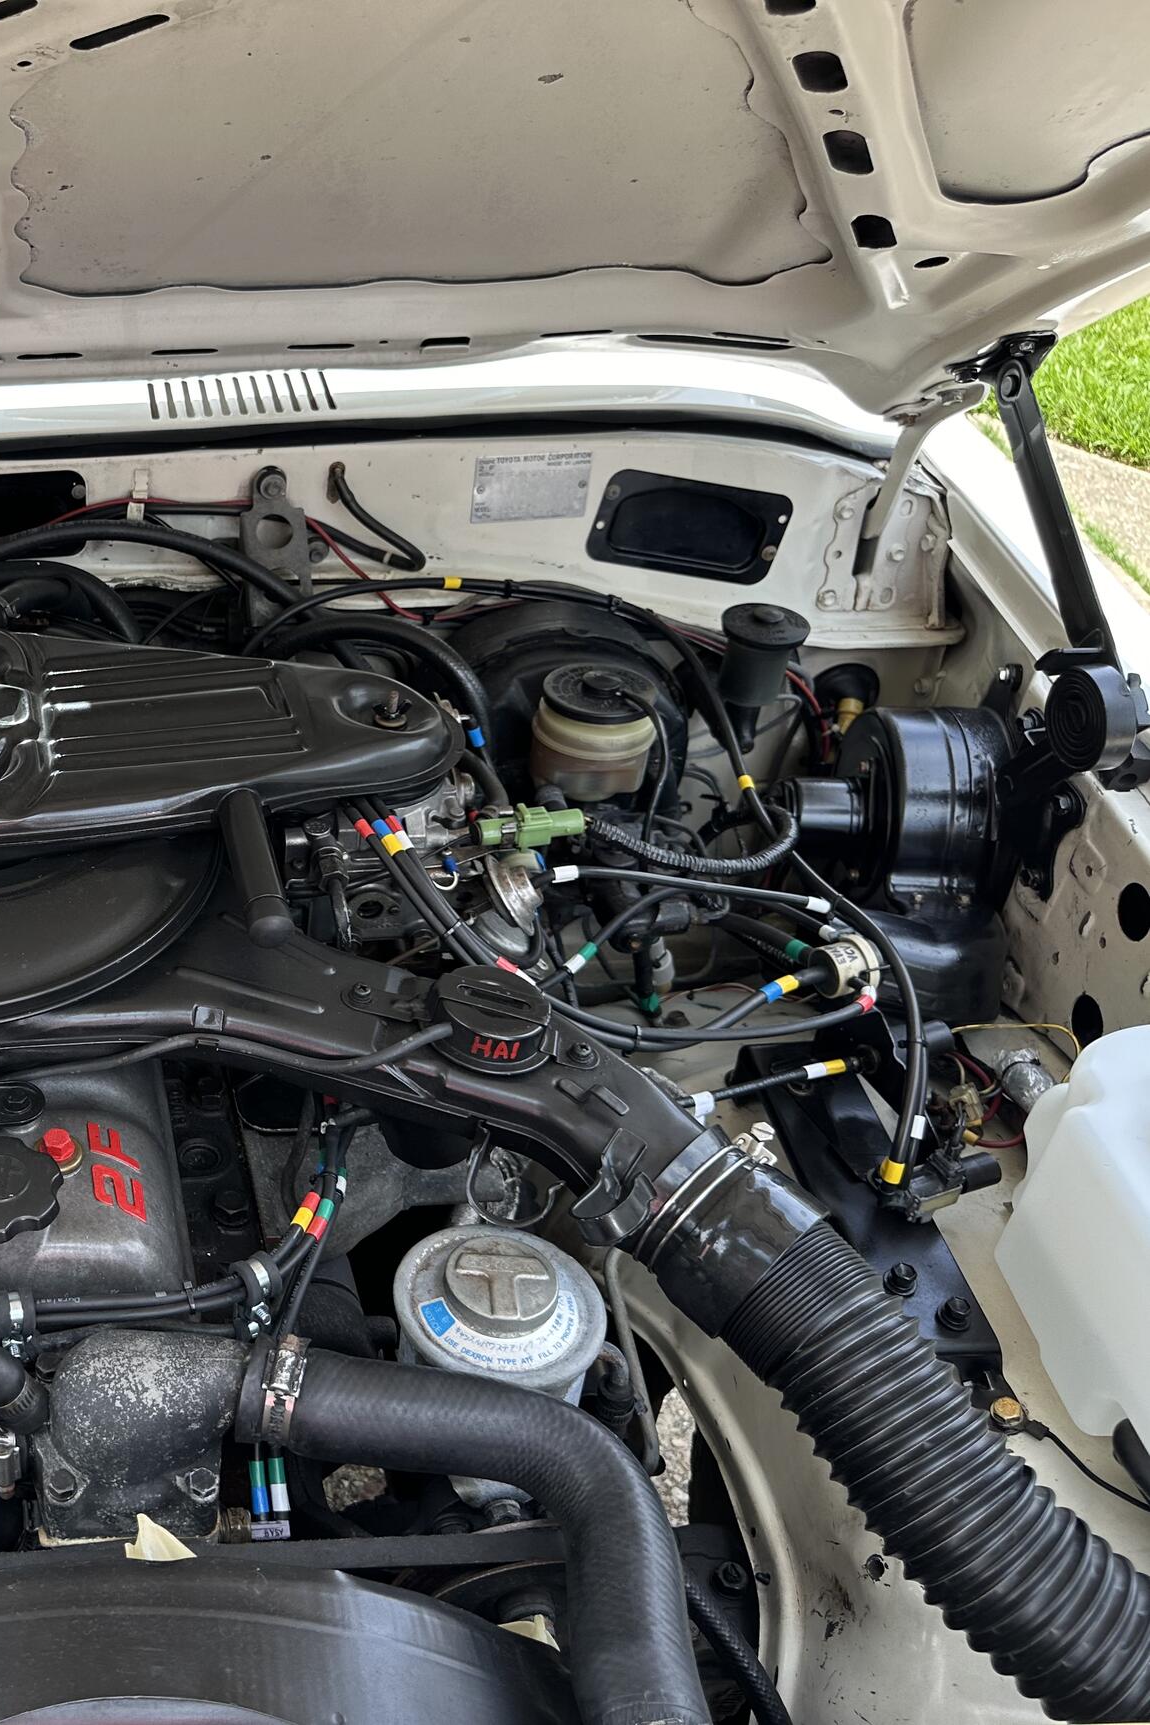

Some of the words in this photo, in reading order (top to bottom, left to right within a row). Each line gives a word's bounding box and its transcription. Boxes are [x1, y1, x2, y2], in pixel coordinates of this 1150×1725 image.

[496, 456, 520, 464] TOYOTA
[523, 454, 546, 463] MOTOR
[548, 452, 592, 461] CORPORATION
[471, 1035, 520, 1060] HAI
[87, 1121, 147, 1225] 2F
[443, 1335, 459, 1349] USE
[460, 1347, 493, 1363] DEXRON
[497, 1358, 518, 1366] TYPE
[538, 1350, 553, 1360] FILL
[552, 1341, 563, 1351] TO
